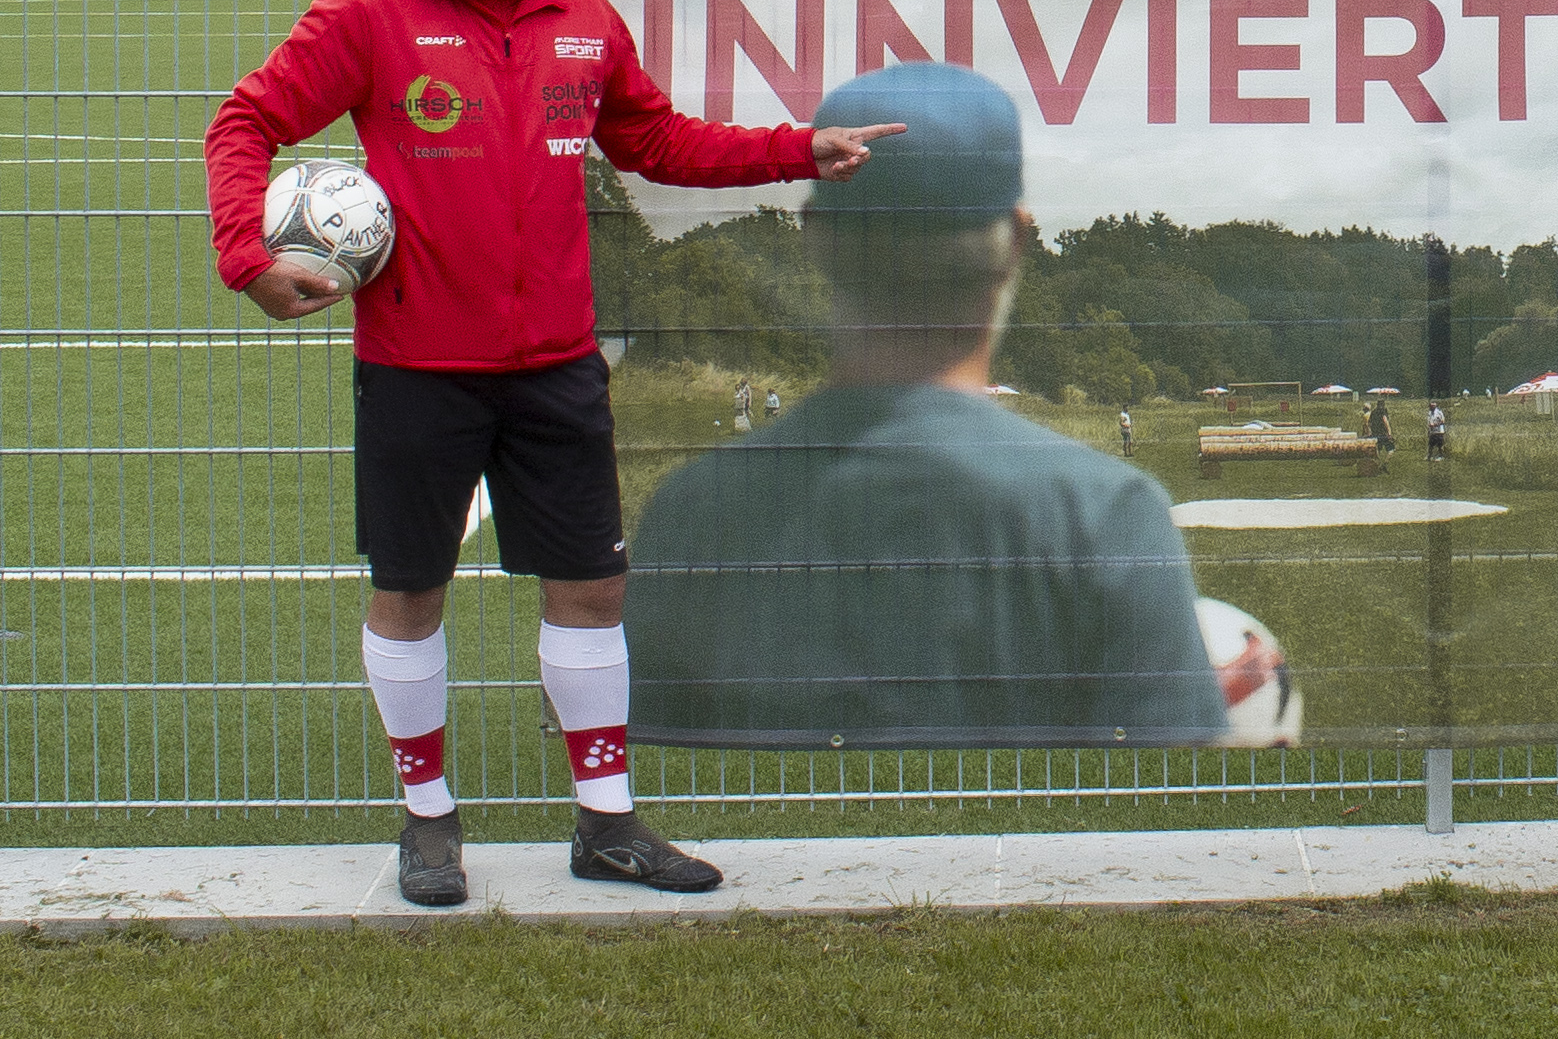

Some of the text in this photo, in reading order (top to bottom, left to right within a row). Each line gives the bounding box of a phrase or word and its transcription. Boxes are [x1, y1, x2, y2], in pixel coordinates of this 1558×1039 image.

[416, 37, 455, 45] CRAFT
[555, 44, 604, 57] SPORT
[390, 97, 482, 112] HIRSCH
